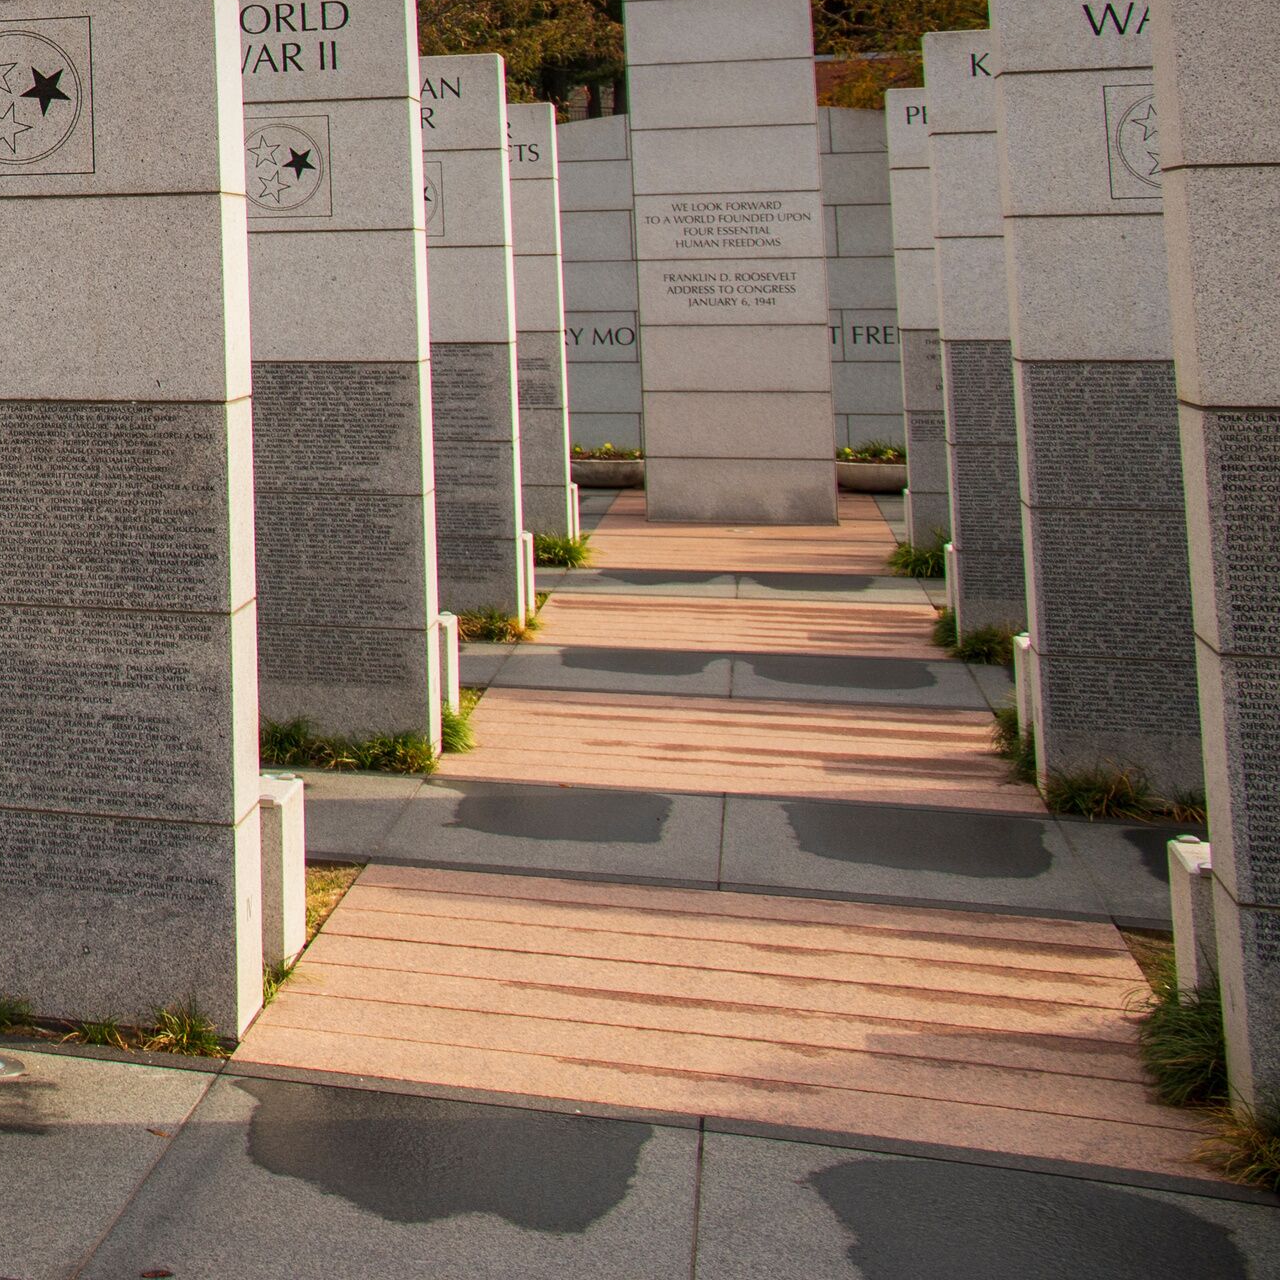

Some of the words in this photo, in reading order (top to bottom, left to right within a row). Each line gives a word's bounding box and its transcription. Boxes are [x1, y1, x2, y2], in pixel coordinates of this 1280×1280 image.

[239, 0, 350, 35] ORLD
[318, 40, 338, 71] II
[672, 203, 687, 212] WE
[692, 203, 722, 211] LOOK
[726, 201, 782, 210] FORWARD
[645, 216, 660, 224] TO
[664, 216, 671, 224] A
[718, 214, 774, 223] FOUNDED
[777, 213, 811, 221] UPON
[684, 227, 714, 235] FOUR
[717, 226, 770, 235] ESSENTIAL
[675, 240, 719, 248] HUMAN
[723, 238, 782, 247] FREEDOMS
[663, 274, 716, 282] FRANKLIN
[735, 272, 796, 281] ROOSEVELT
[667, 286, 715, 294] ADDRESS
[737, 284, 796, 293] CONGRESS
[688, 298, 737, 307] JANUARY
[742, 298, 750, 307] 6,
[851, 326, 900, 345] FRE
[1218, 414, 1243, 422] POLK
[1245, 414, 1280, 423] COUN
[1219, 424, 1262, 433] WILLIAM
[1221, 464, 1247, 472] RHEA
[1222, 483, 1257, 493] ROANE
[1229, 564, 1261, 573] SCOTT
